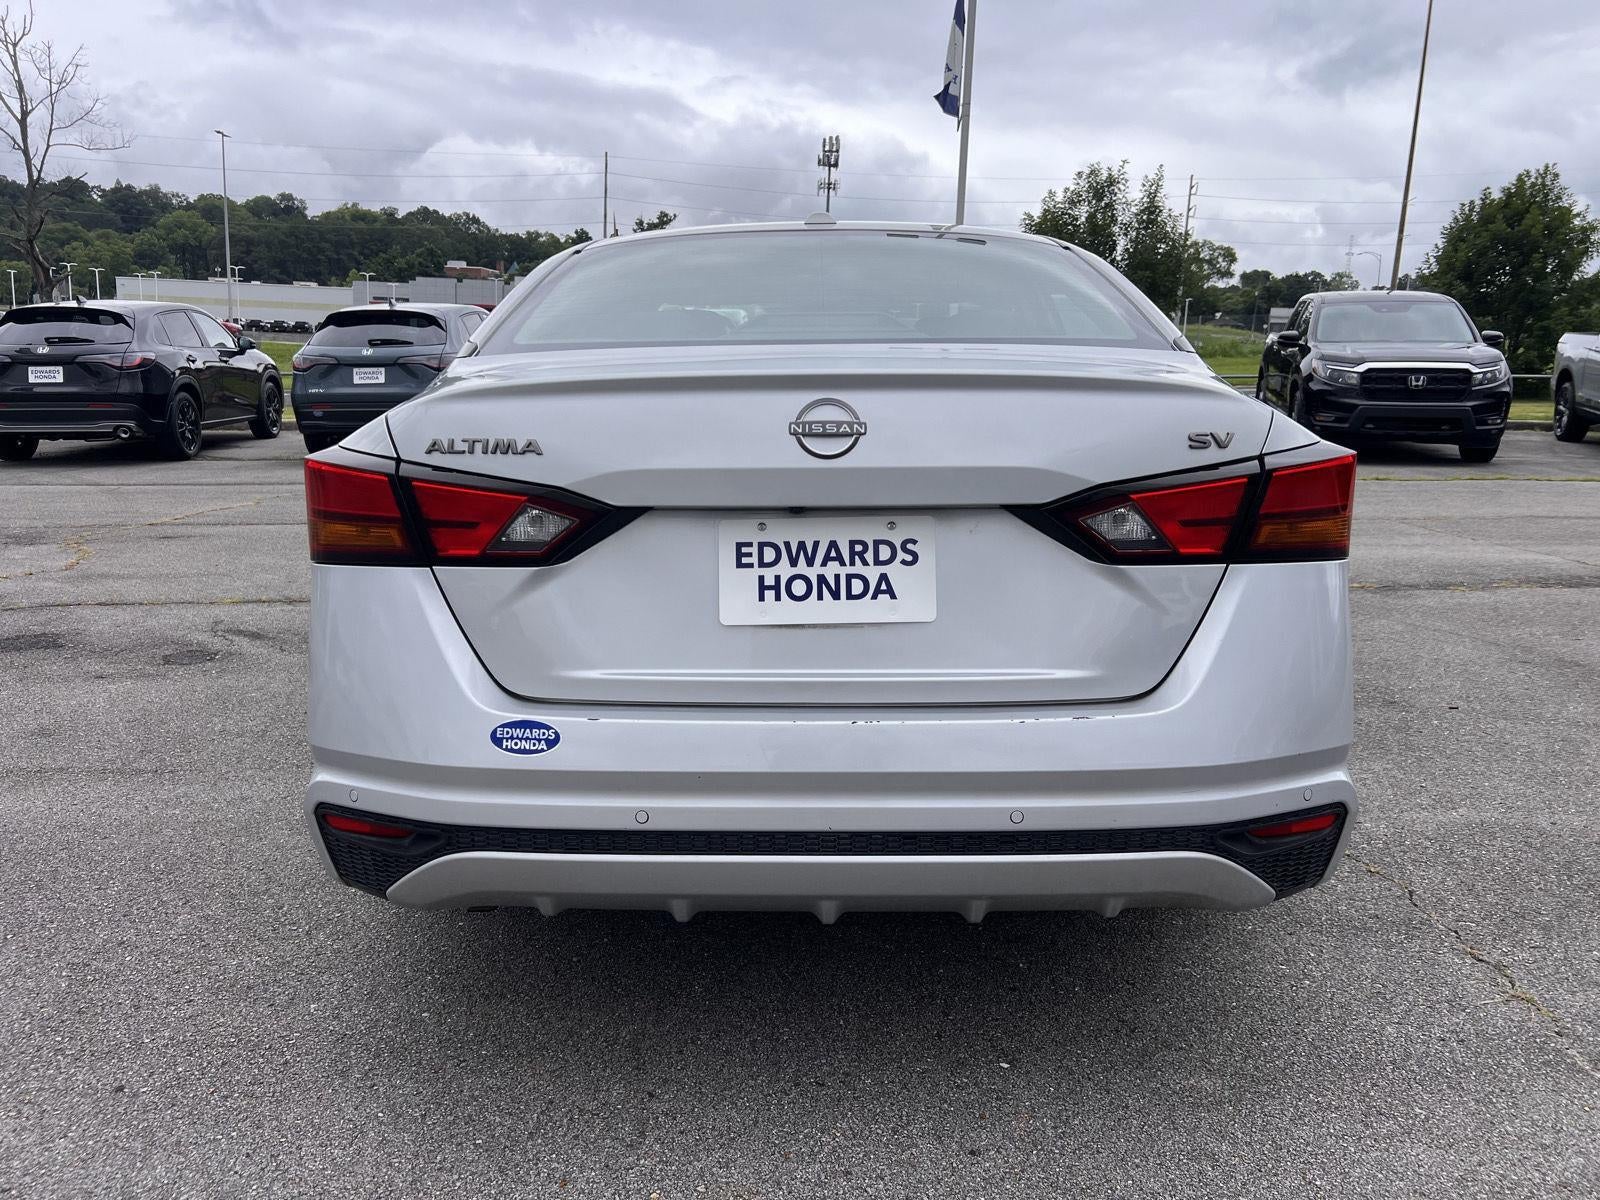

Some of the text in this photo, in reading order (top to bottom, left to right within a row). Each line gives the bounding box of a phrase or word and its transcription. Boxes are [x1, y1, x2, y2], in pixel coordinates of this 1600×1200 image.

[790, 422, 866, 434] NISSAN
[424, 438, 544, 456] ALTIMA
[1187, 431, 1235, 450] SV
[735, 537, 920, 570] EDWARDS
[757, 572, 898, 603] HONDA
[496, 727, 556, 739] EDWARDS
[502, 739, 547, 750] HONDA
